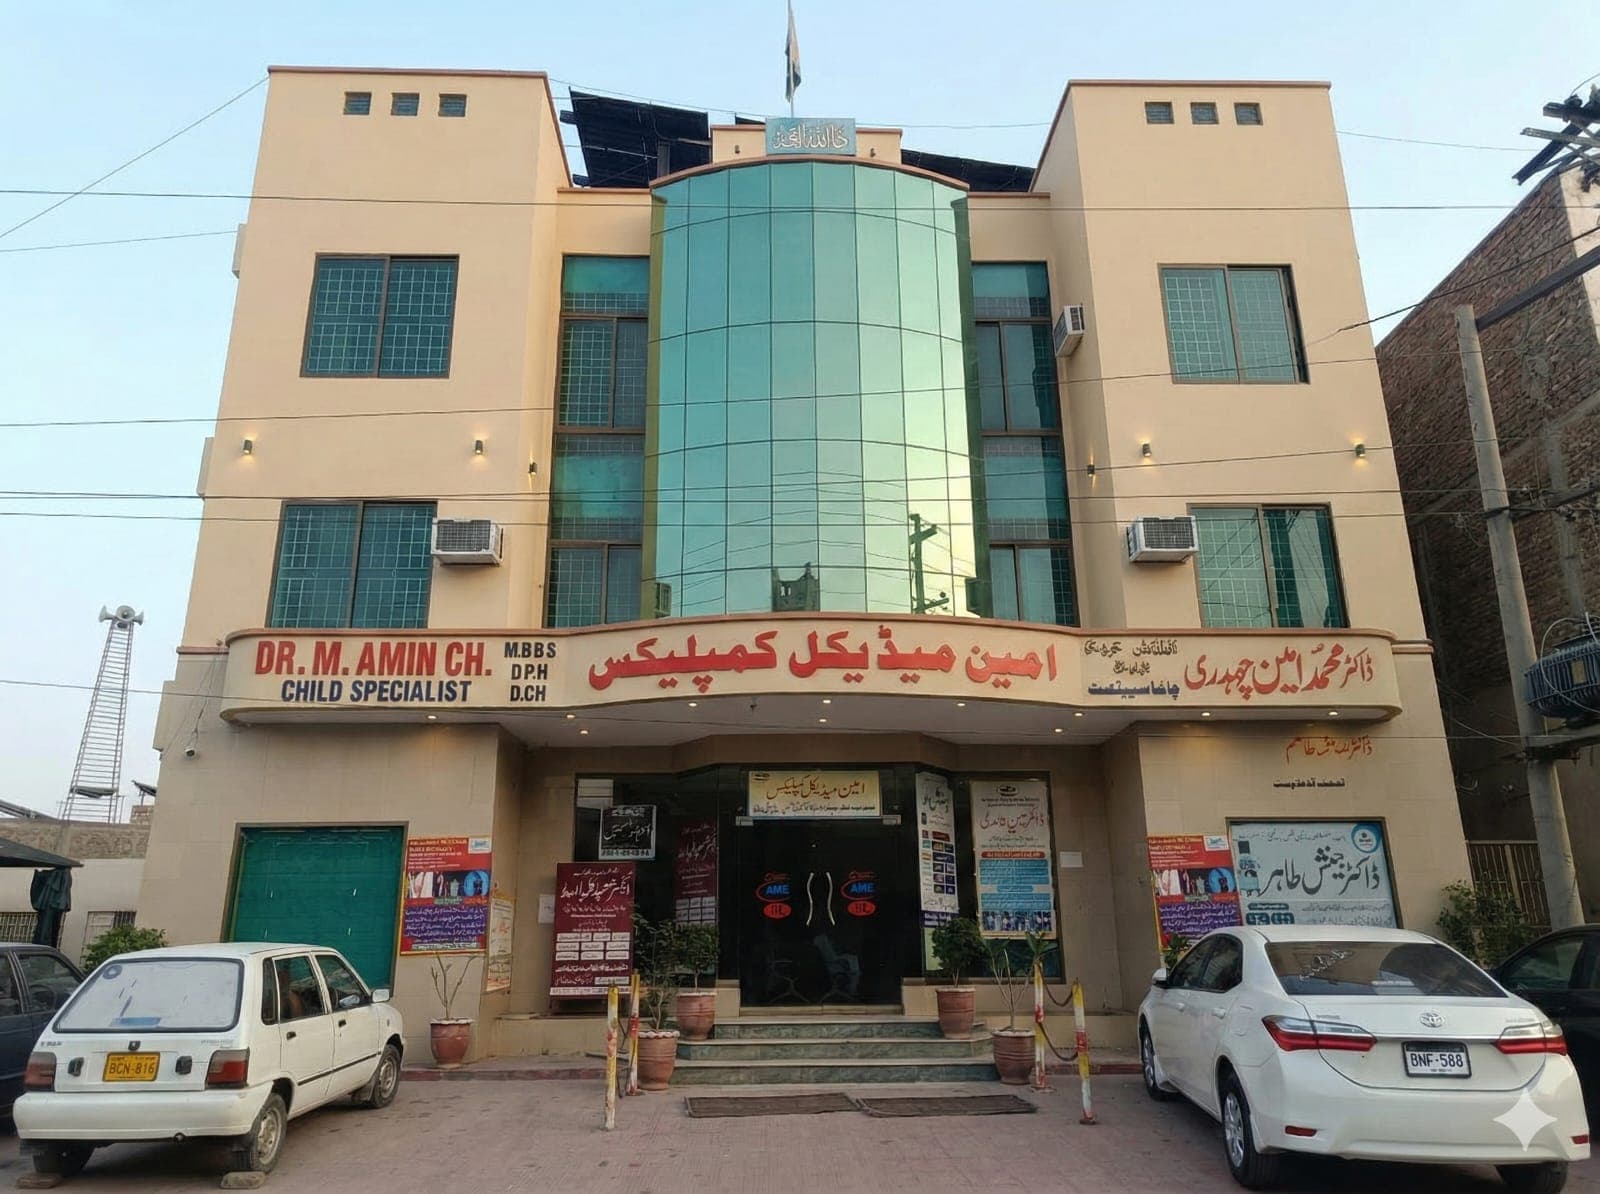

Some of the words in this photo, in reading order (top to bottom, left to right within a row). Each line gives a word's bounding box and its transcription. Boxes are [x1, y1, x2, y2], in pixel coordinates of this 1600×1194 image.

[255, 641, 305, 675] DR.
[312, 641, 349, 676] M.
[356, 642, 437, 676] AMIN
[445, 642, 492, 677] CH.
[589, 631, 778, 693] کمپلیکس
[789, 625, 956, 683] میڈیکل
[966, 643, 1057, 688] امین
[1252, 646, 1302, 694] امین
[1340, 647, 1374, 688] ڈاکٹر
[281, 680, 343, 702] CHILD
[350, 680, 472, 702] SPECIALIST
[766, 884, 790, 895] AME
[1258, 858, 1301, 897] طاہر
[1339, 856, 1380, 896] ڈاکٹر
[1410, 1053, 1464, 1067] BNF-588
